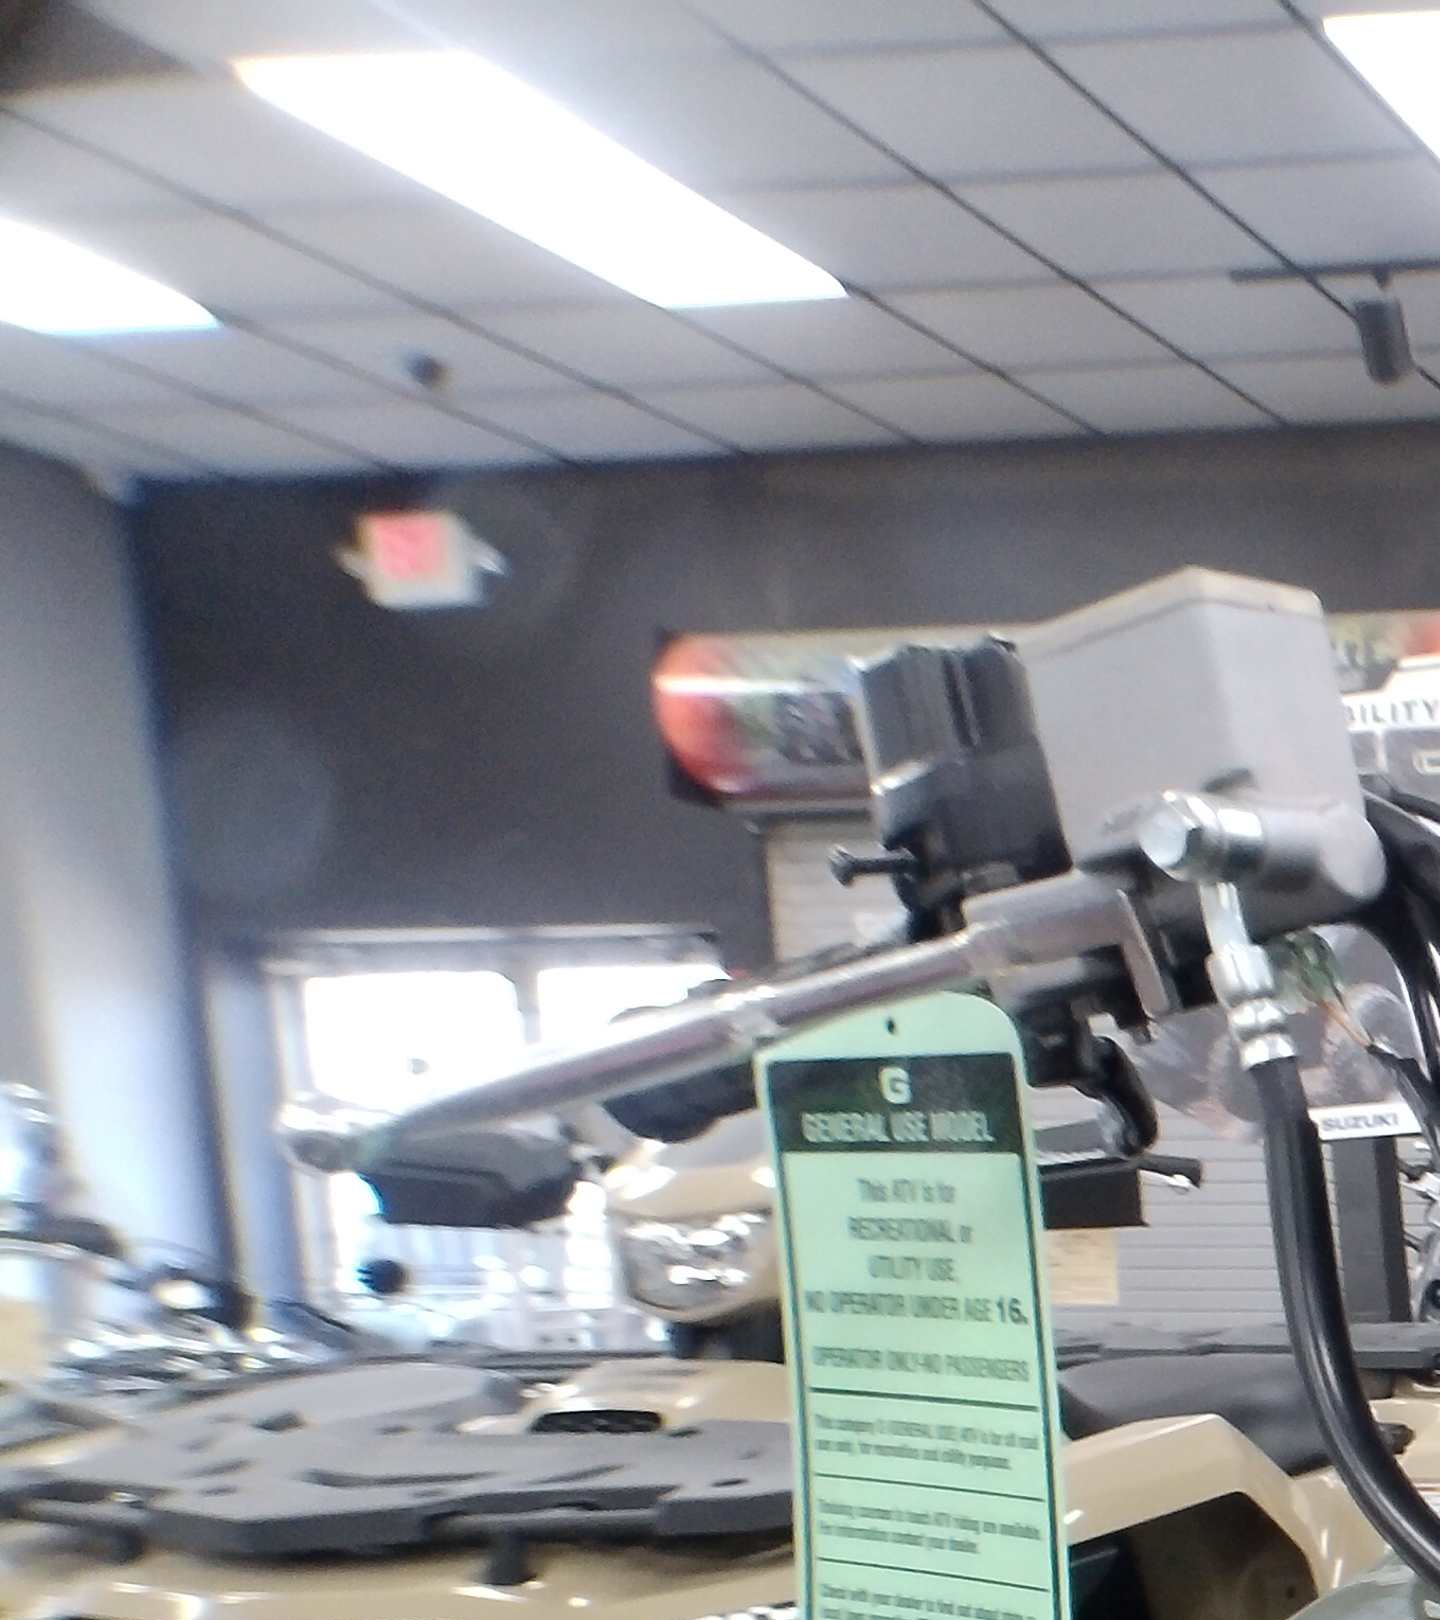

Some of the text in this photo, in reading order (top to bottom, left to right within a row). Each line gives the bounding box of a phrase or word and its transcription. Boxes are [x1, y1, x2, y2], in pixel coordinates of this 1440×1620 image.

[879, 1067, 912, 1104] G
[801, 1112, 892, 1142] GENERAL
[891, 1111, 929, 1142] USE
[1321, 1112, 1399, 1131] SUZUKI
